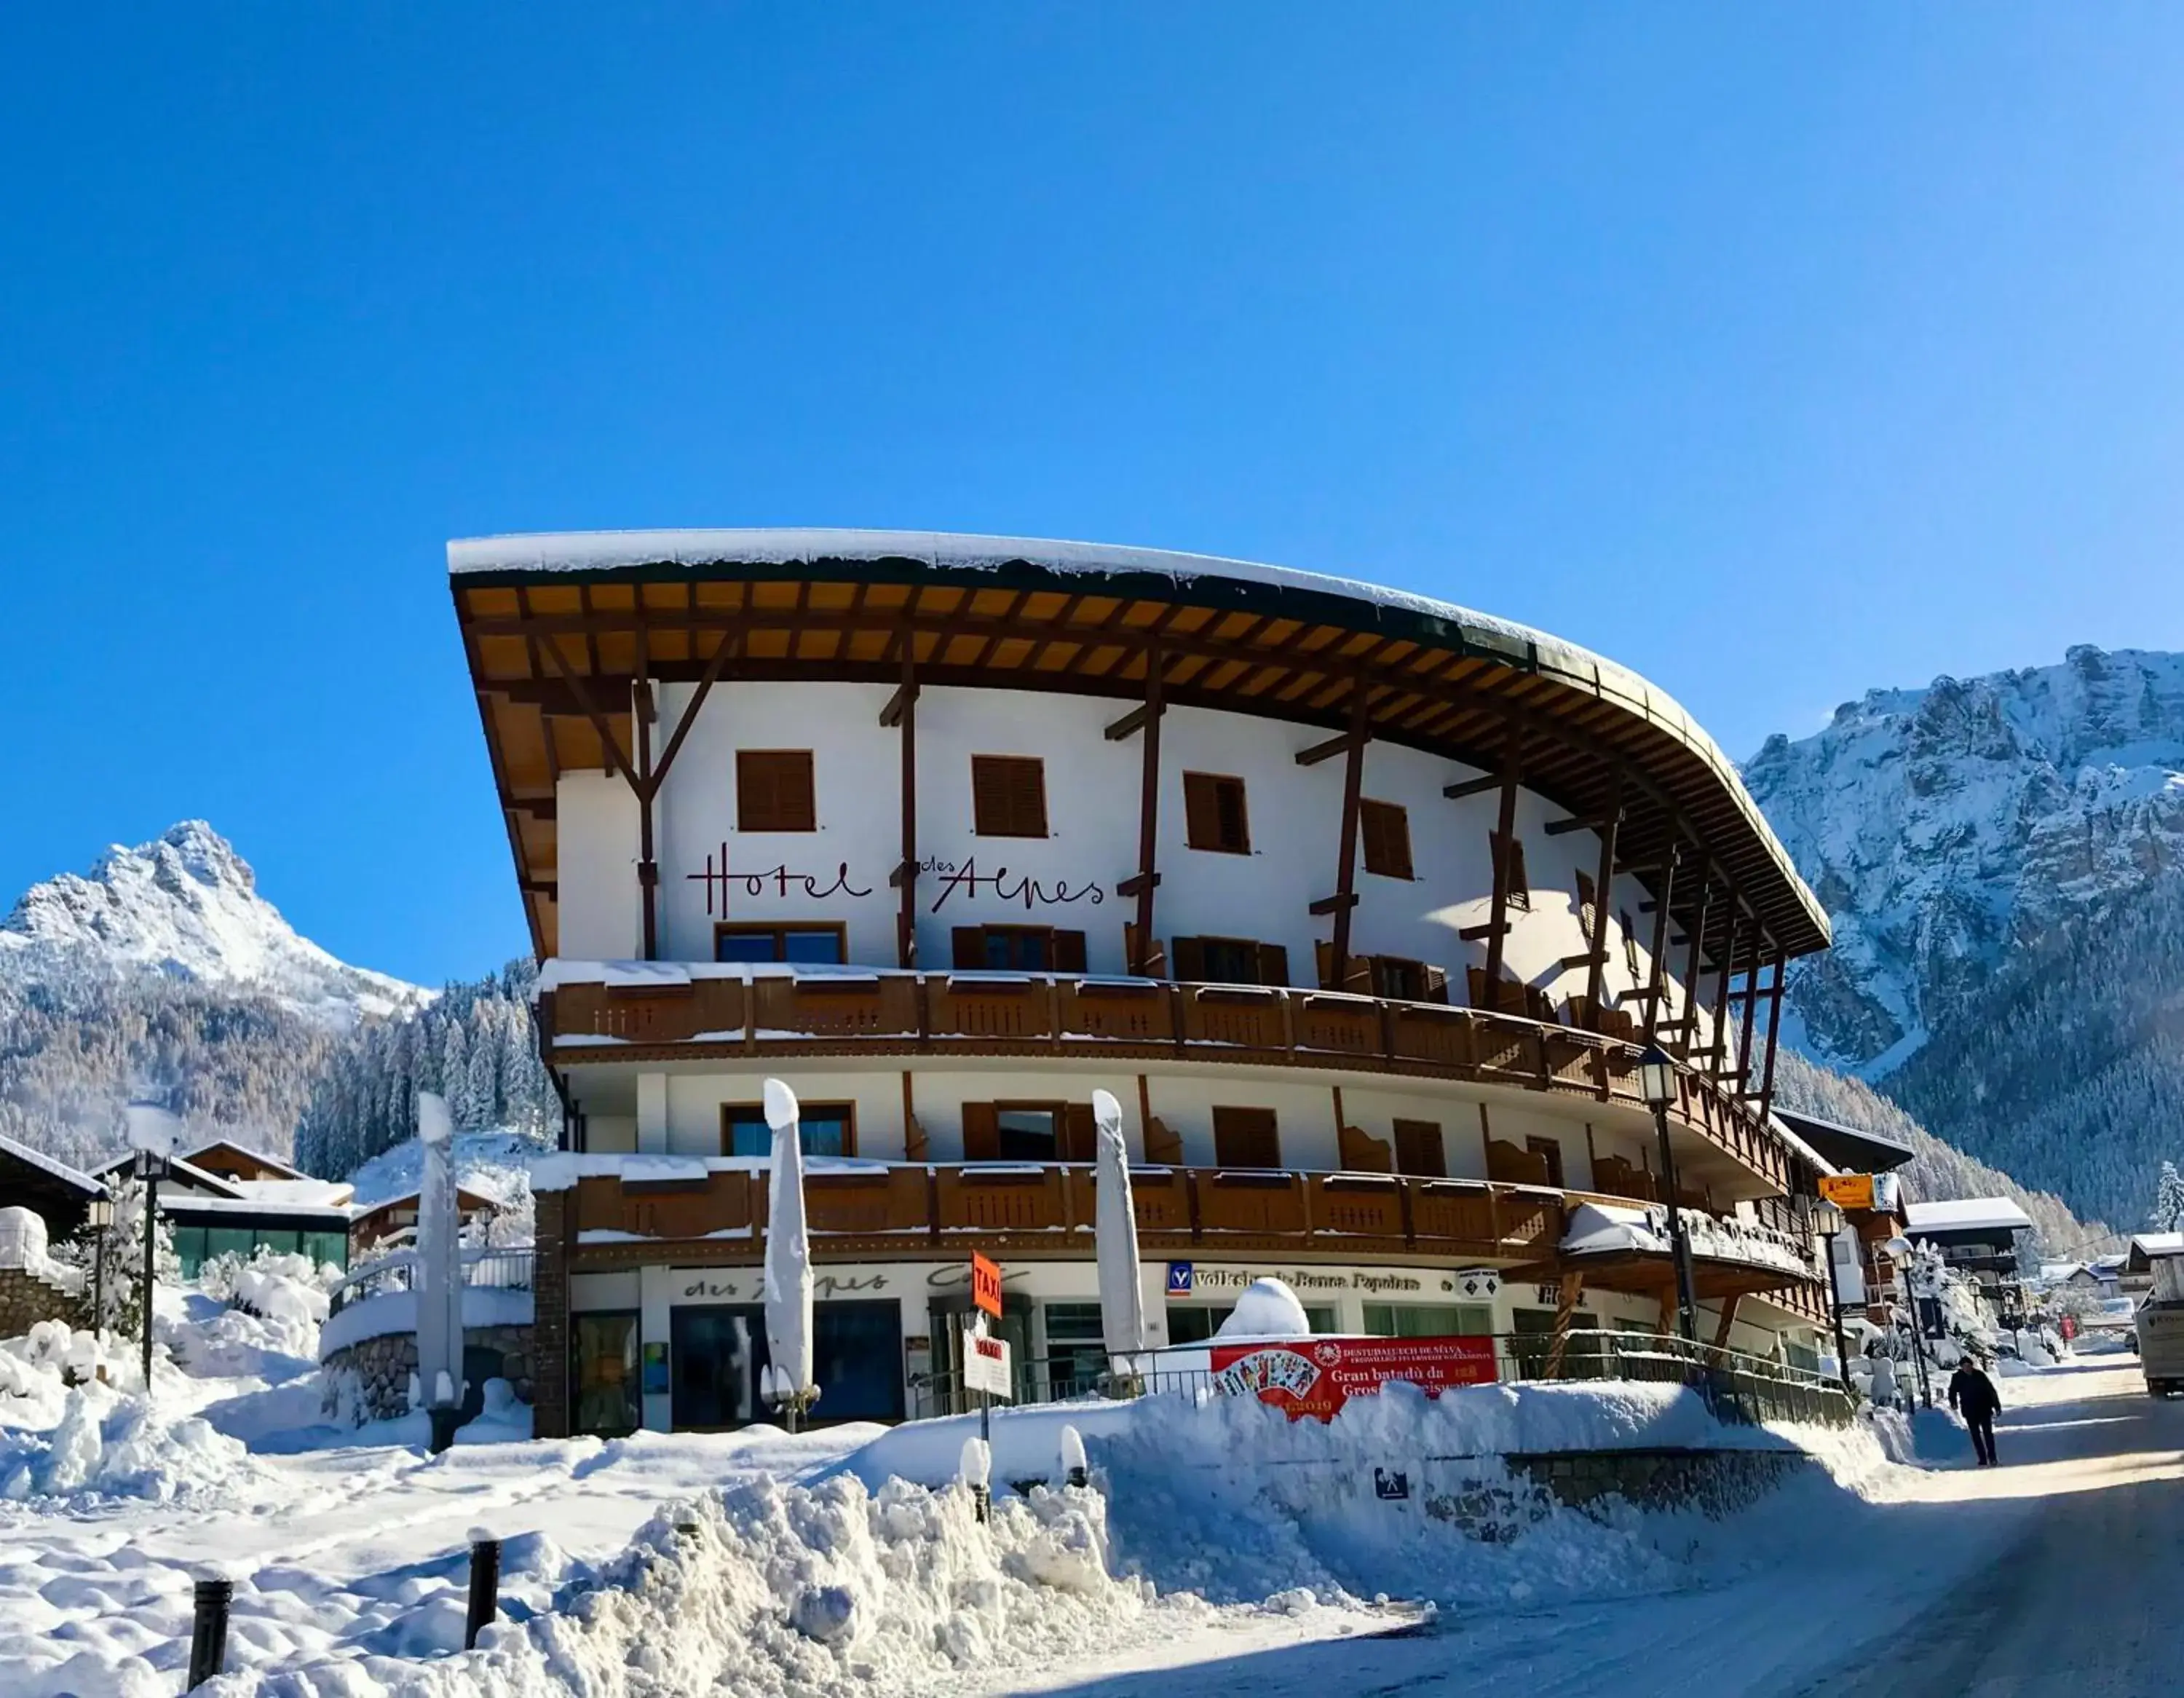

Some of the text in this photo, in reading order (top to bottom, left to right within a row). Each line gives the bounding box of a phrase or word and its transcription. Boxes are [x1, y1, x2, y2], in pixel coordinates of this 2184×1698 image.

[687, 842, 1104, 920] Hotel des Alpes
[684, 1280, 739, 1297] des
[976, 1268, 1000, 1303] TAXI
[1331, 1370, 1369, 1382] Gran
[1426, 1365, 1443, 1378] da
